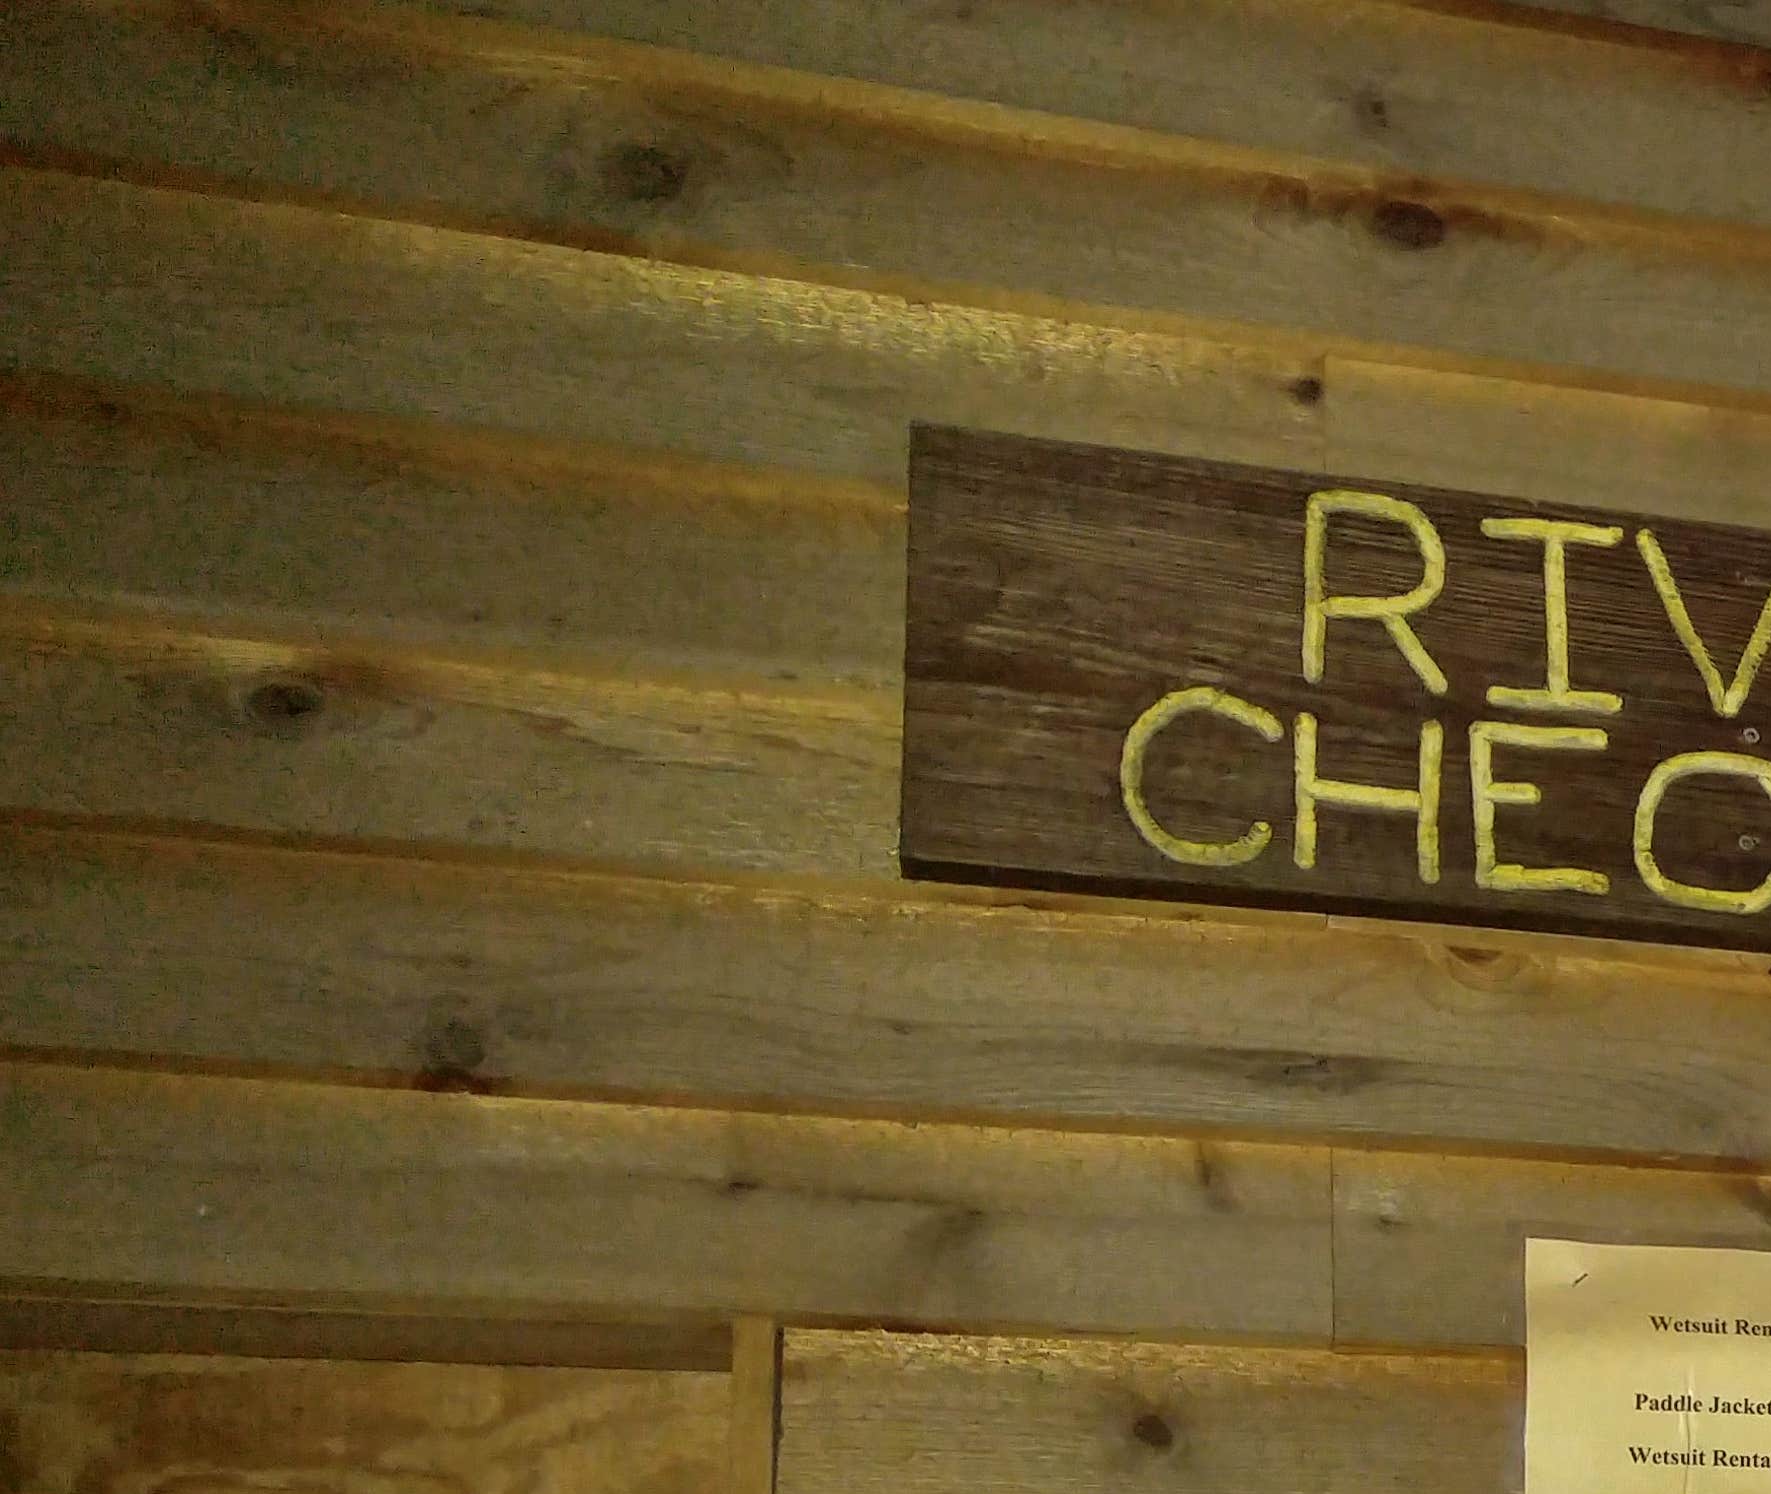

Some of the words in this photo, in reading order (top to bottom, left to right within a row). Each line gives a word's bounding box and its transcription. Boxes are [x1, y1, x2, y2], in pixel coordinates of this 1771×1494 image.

[1649, 1316, 1728, 1335] Wetsuit
[1634, 1393, 1702, 1413] Paddle
[1628, 1446, 1706, 1466] Wetsuit
